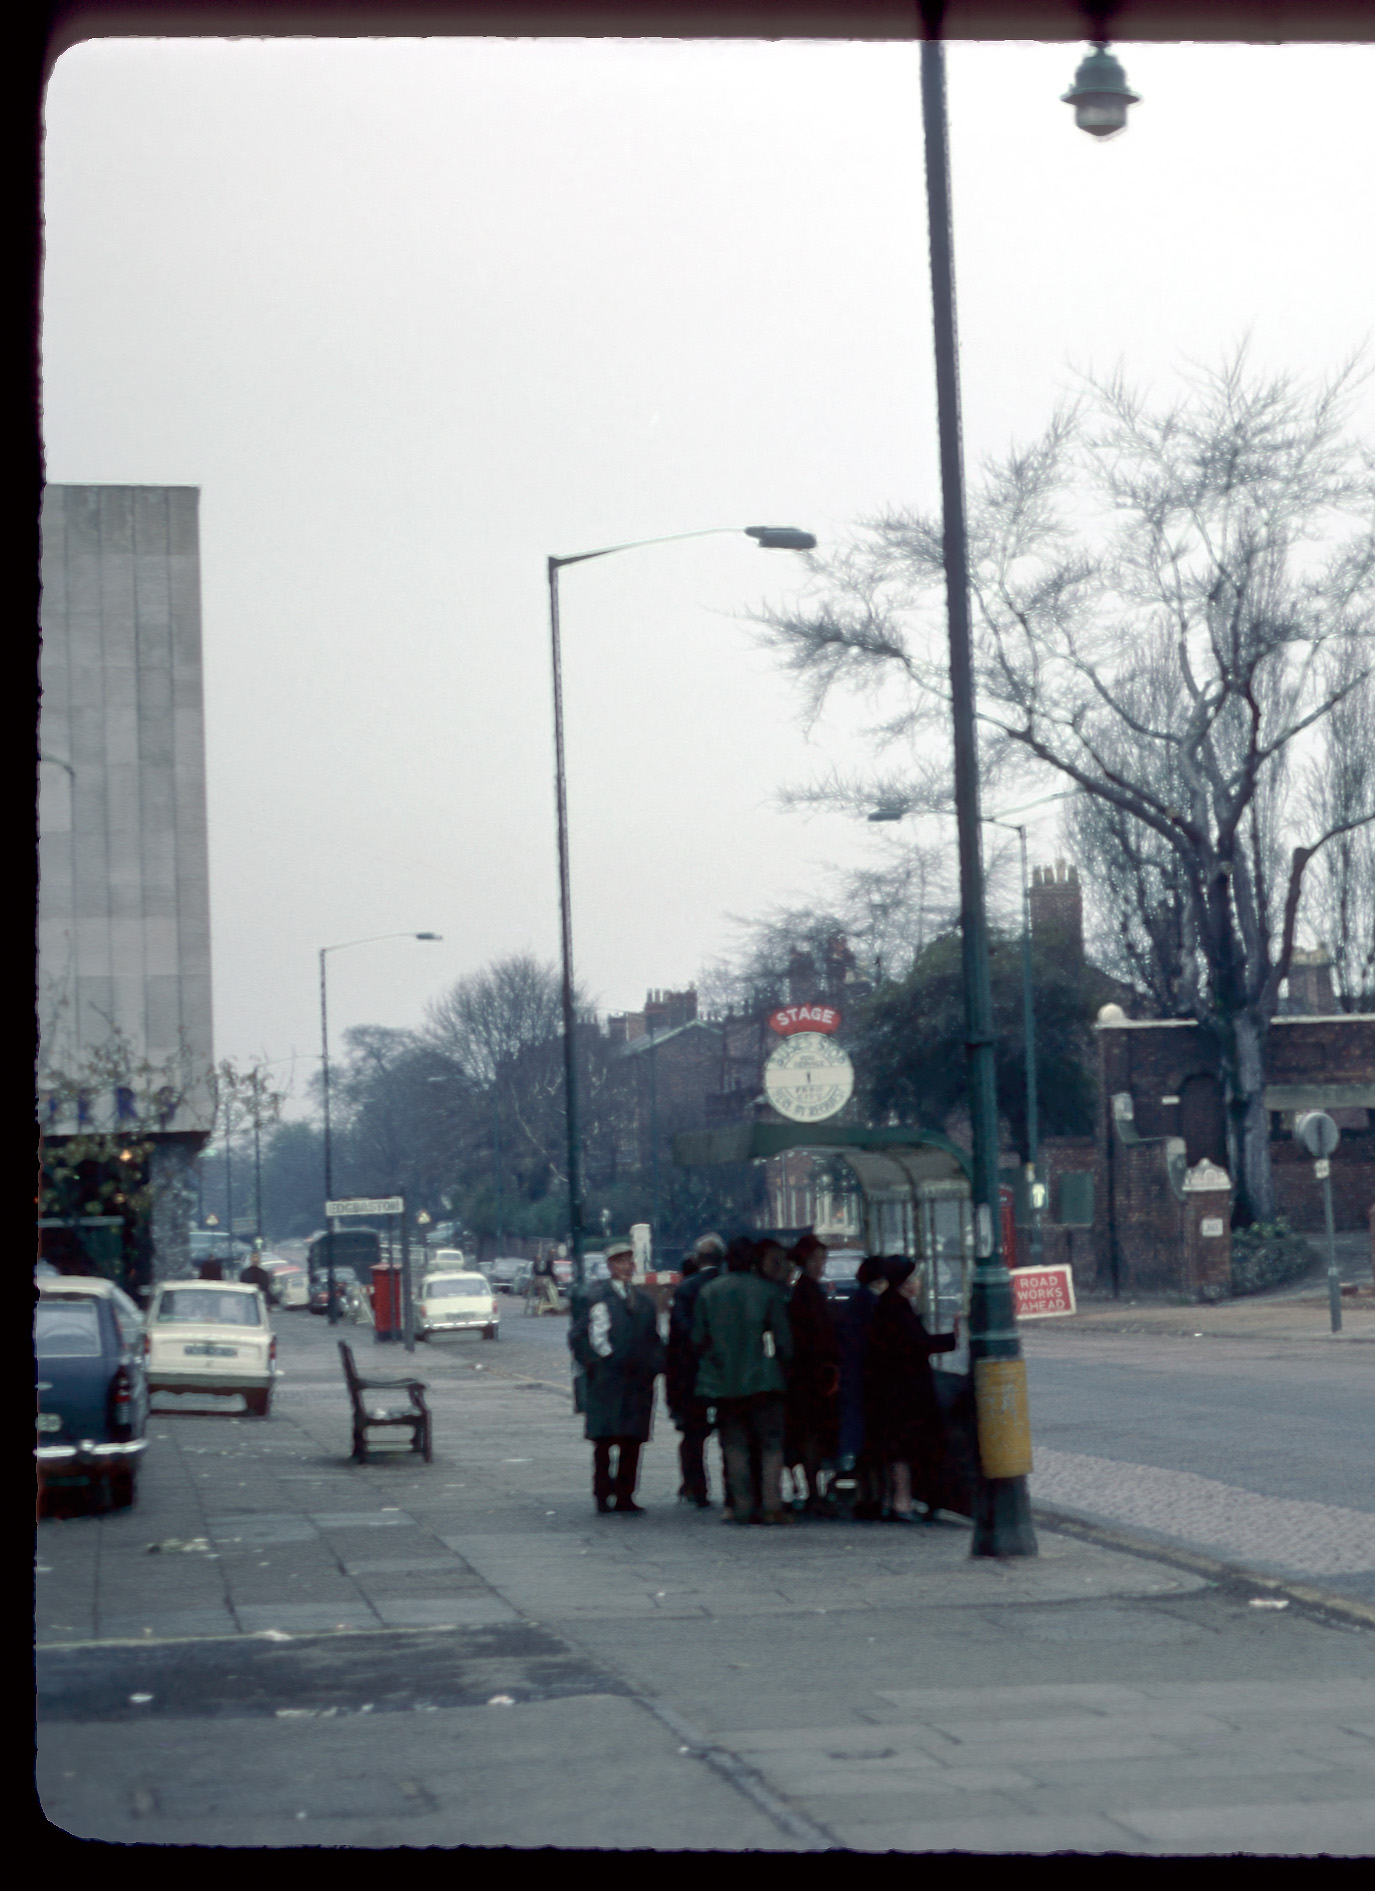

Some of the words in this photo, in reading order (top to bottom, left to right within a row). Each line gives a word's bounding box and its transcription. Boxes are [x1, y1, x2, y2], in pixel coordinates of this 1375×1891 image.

[776, 1007, 835, 1025] STAGE
[1020, 1275, 1058, 1288] ROAD
[1017, 1287, 1063, 1300] WORKS
[1020, 1299, 1066, 1311] AHEAD
